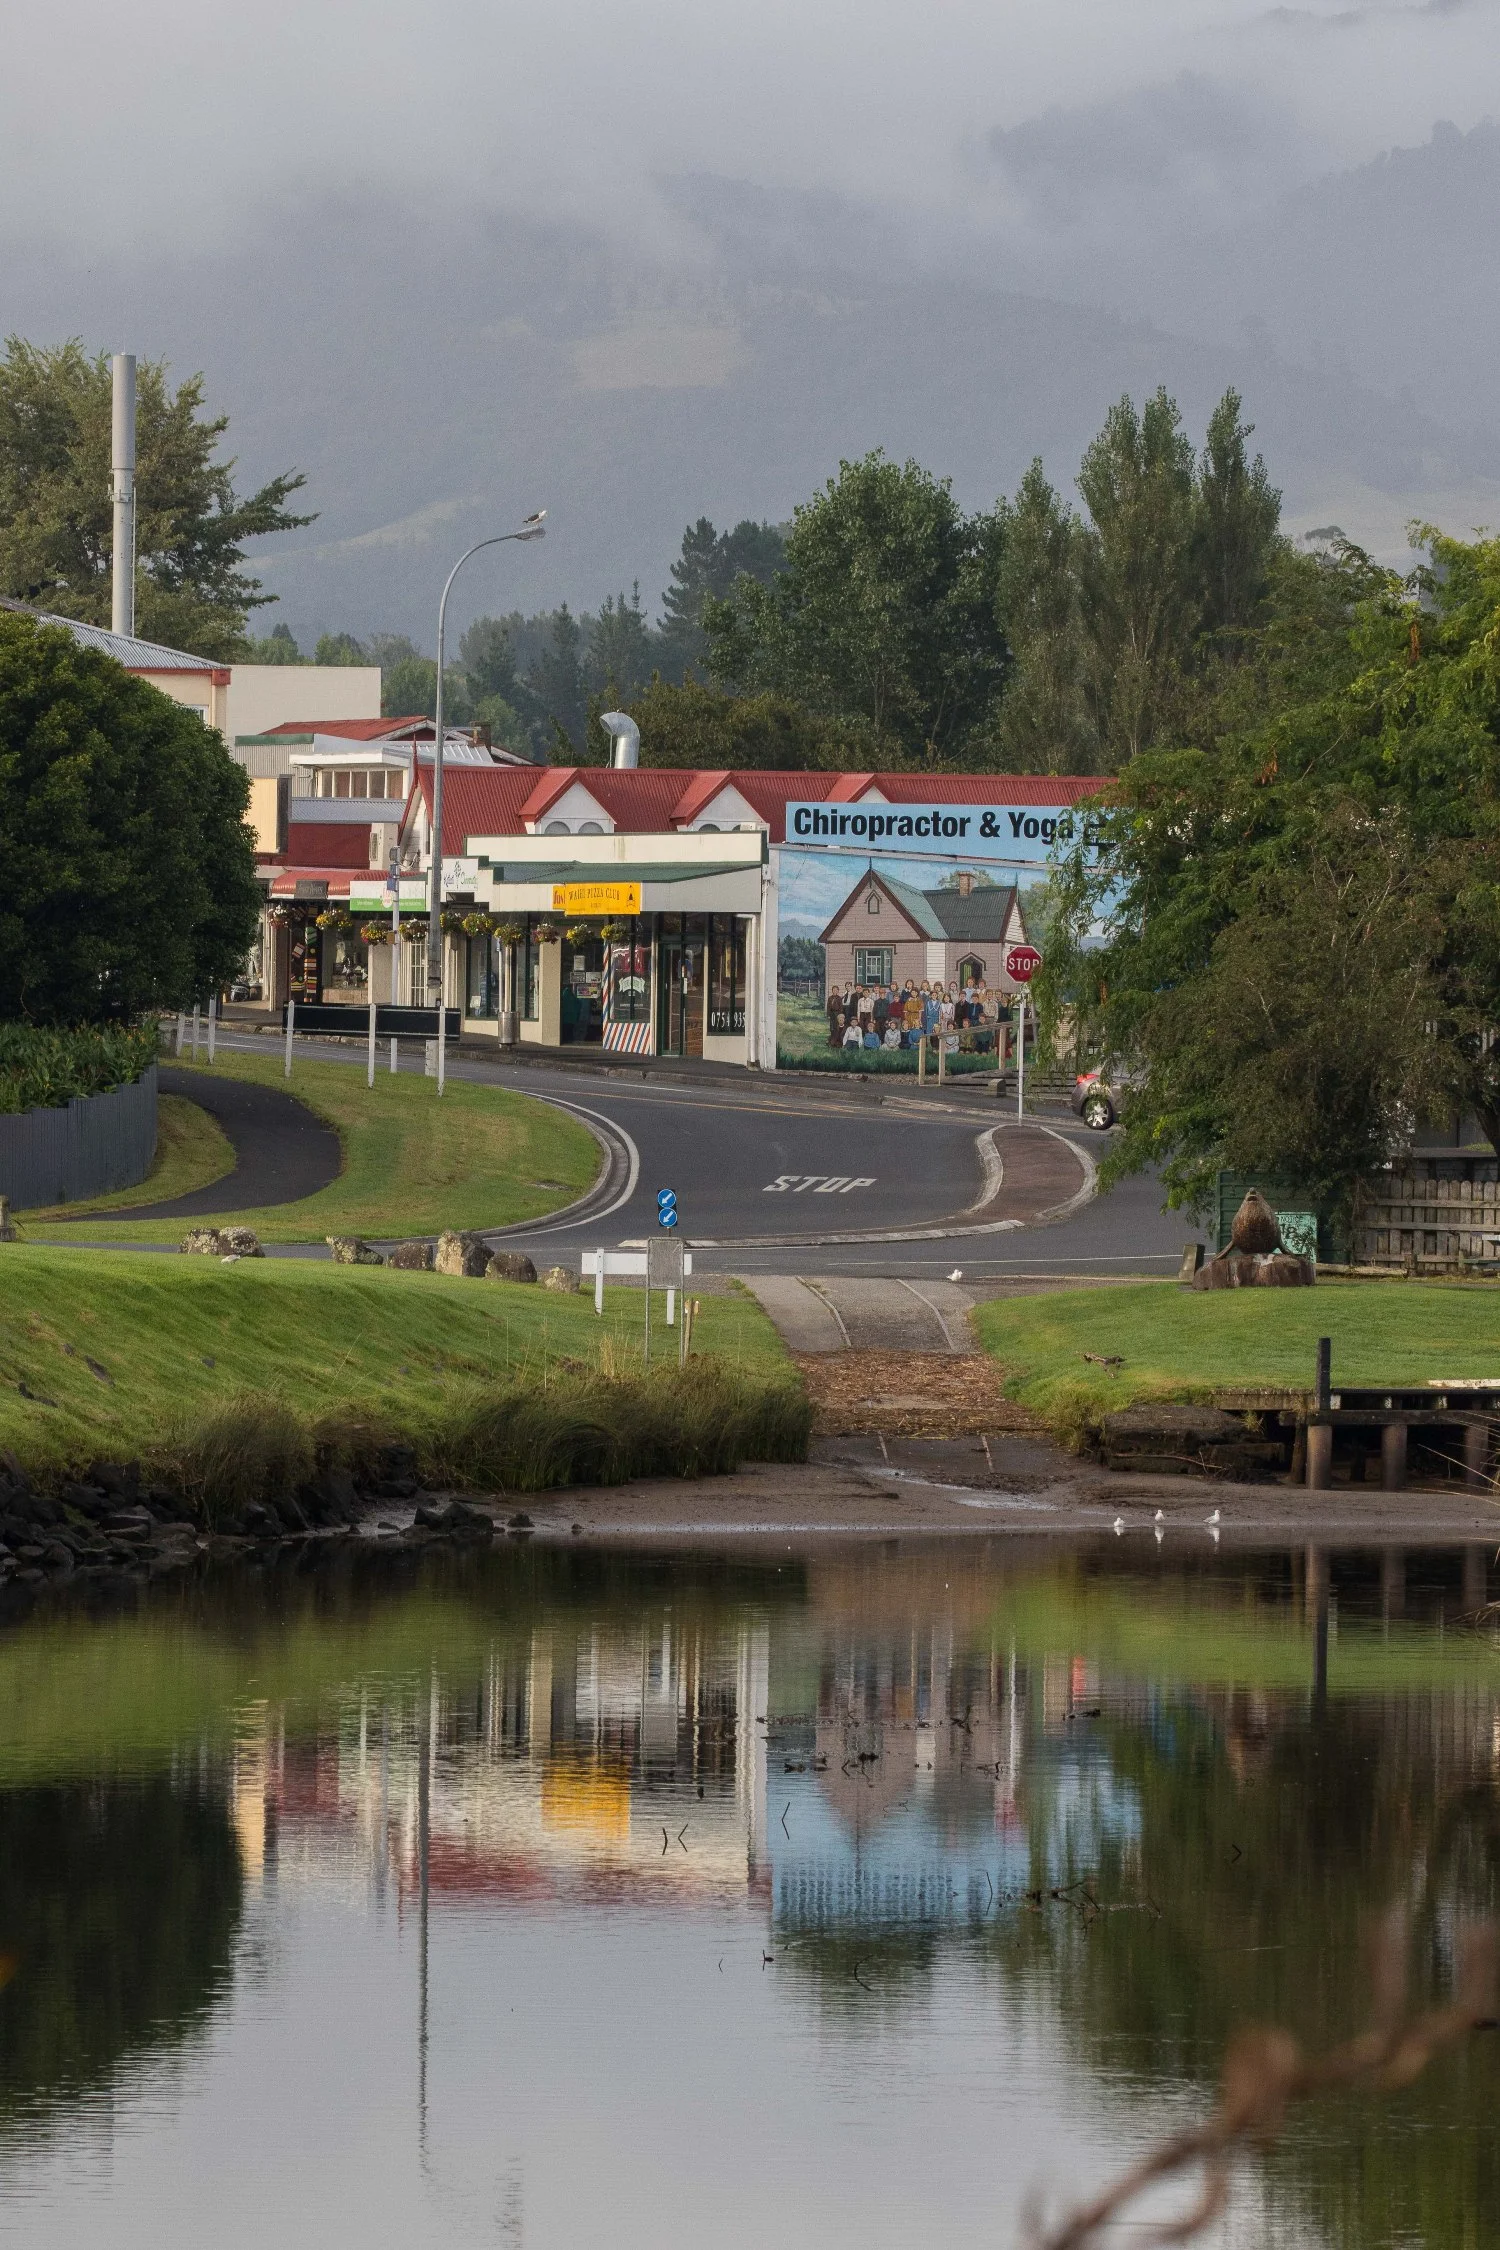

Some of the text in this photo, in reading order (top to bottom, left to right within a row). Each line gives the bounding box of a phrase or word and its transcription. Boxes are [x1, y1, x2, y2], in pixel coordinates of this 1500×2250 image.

[794, 808, 971, 841] Chiropractor
[979, 811, 1000, 838] &
[605, 887, 620, 901] CLUB
[1008, 958, 1040, 971] STOP
[762, 1175, 877, 1193] STOP
